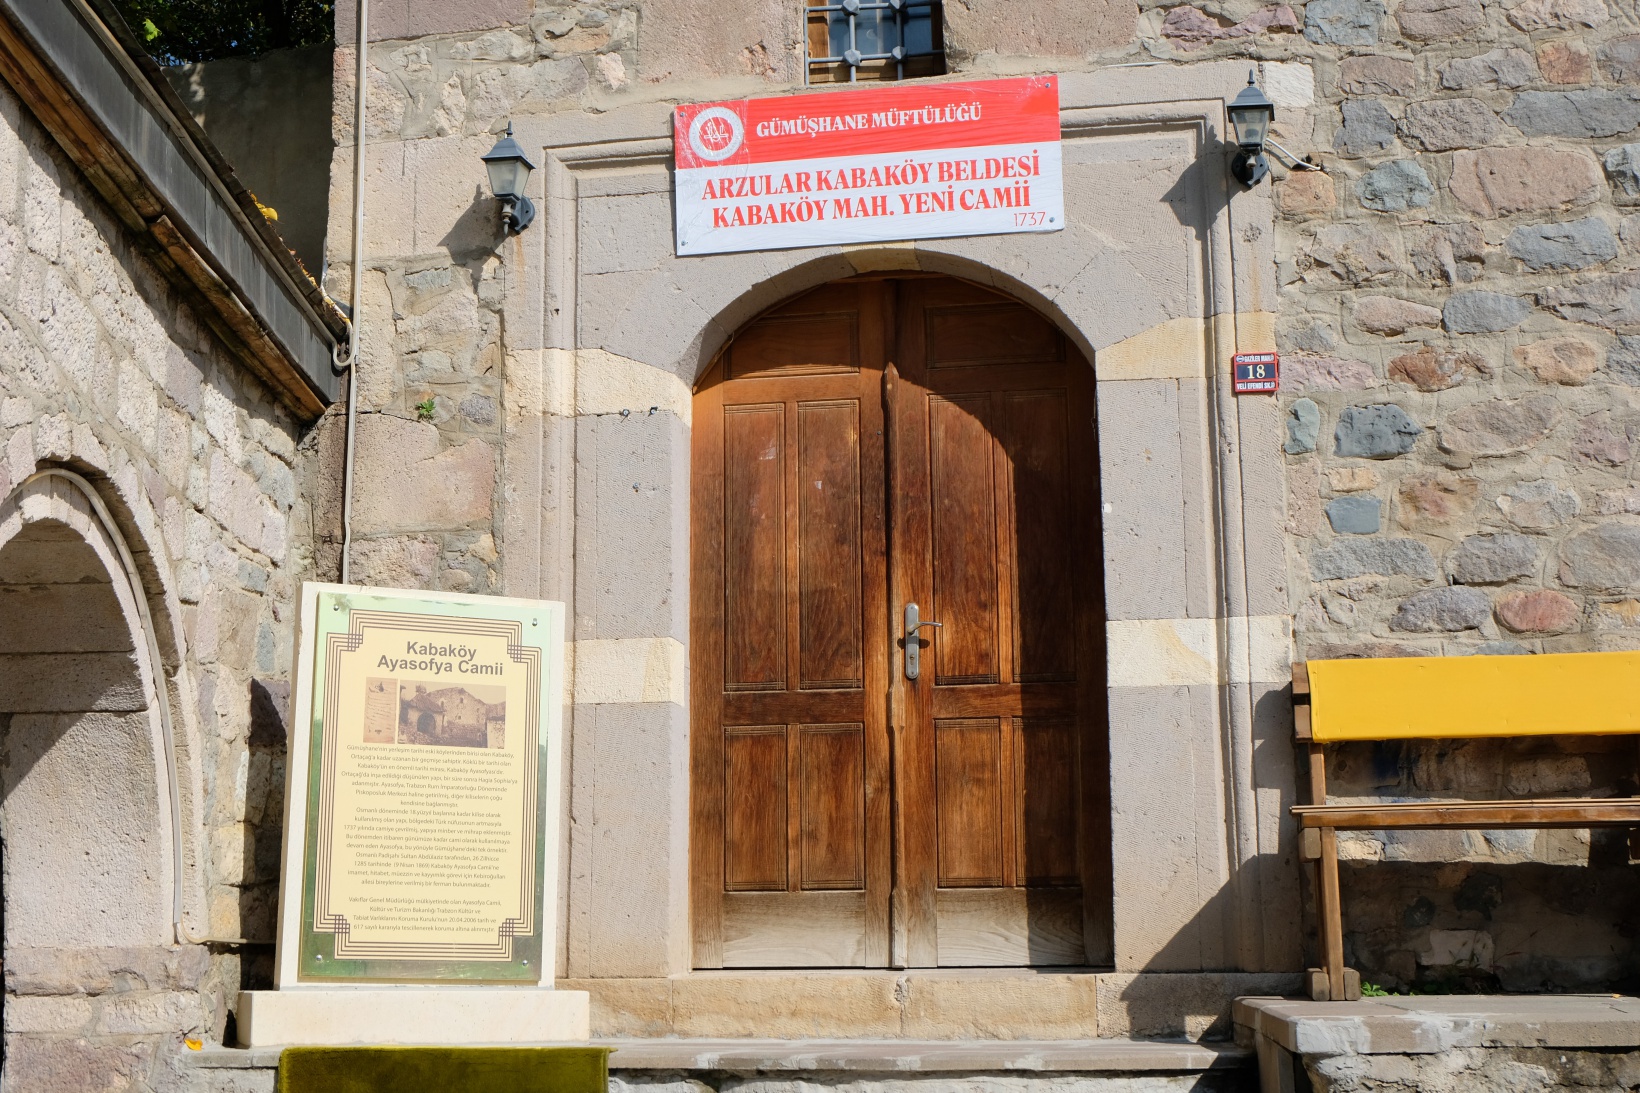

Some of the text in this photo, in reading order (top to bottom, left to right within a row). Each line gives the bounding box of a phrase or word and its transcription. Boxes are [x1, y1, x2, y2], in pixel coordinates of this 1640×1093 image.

[756, 113, 868, 137] GÜMÜŞHANE
[871, 102, 982, 127] MÜFTÜLÜĞÜ
[701, 149, 1040, 200] ARZULAR KABAKÖY BELDESİ
[712, 180, 1031, 228] KABAKÖY MAH. YENİ CAMİİ
[1013, 211, 1046, 227] 1737
[1247, 364, 1266, 379] 18
[406, 641, 477, 661] Kabaköy
[377, 654, 503, 675] Ayasofya Camii
